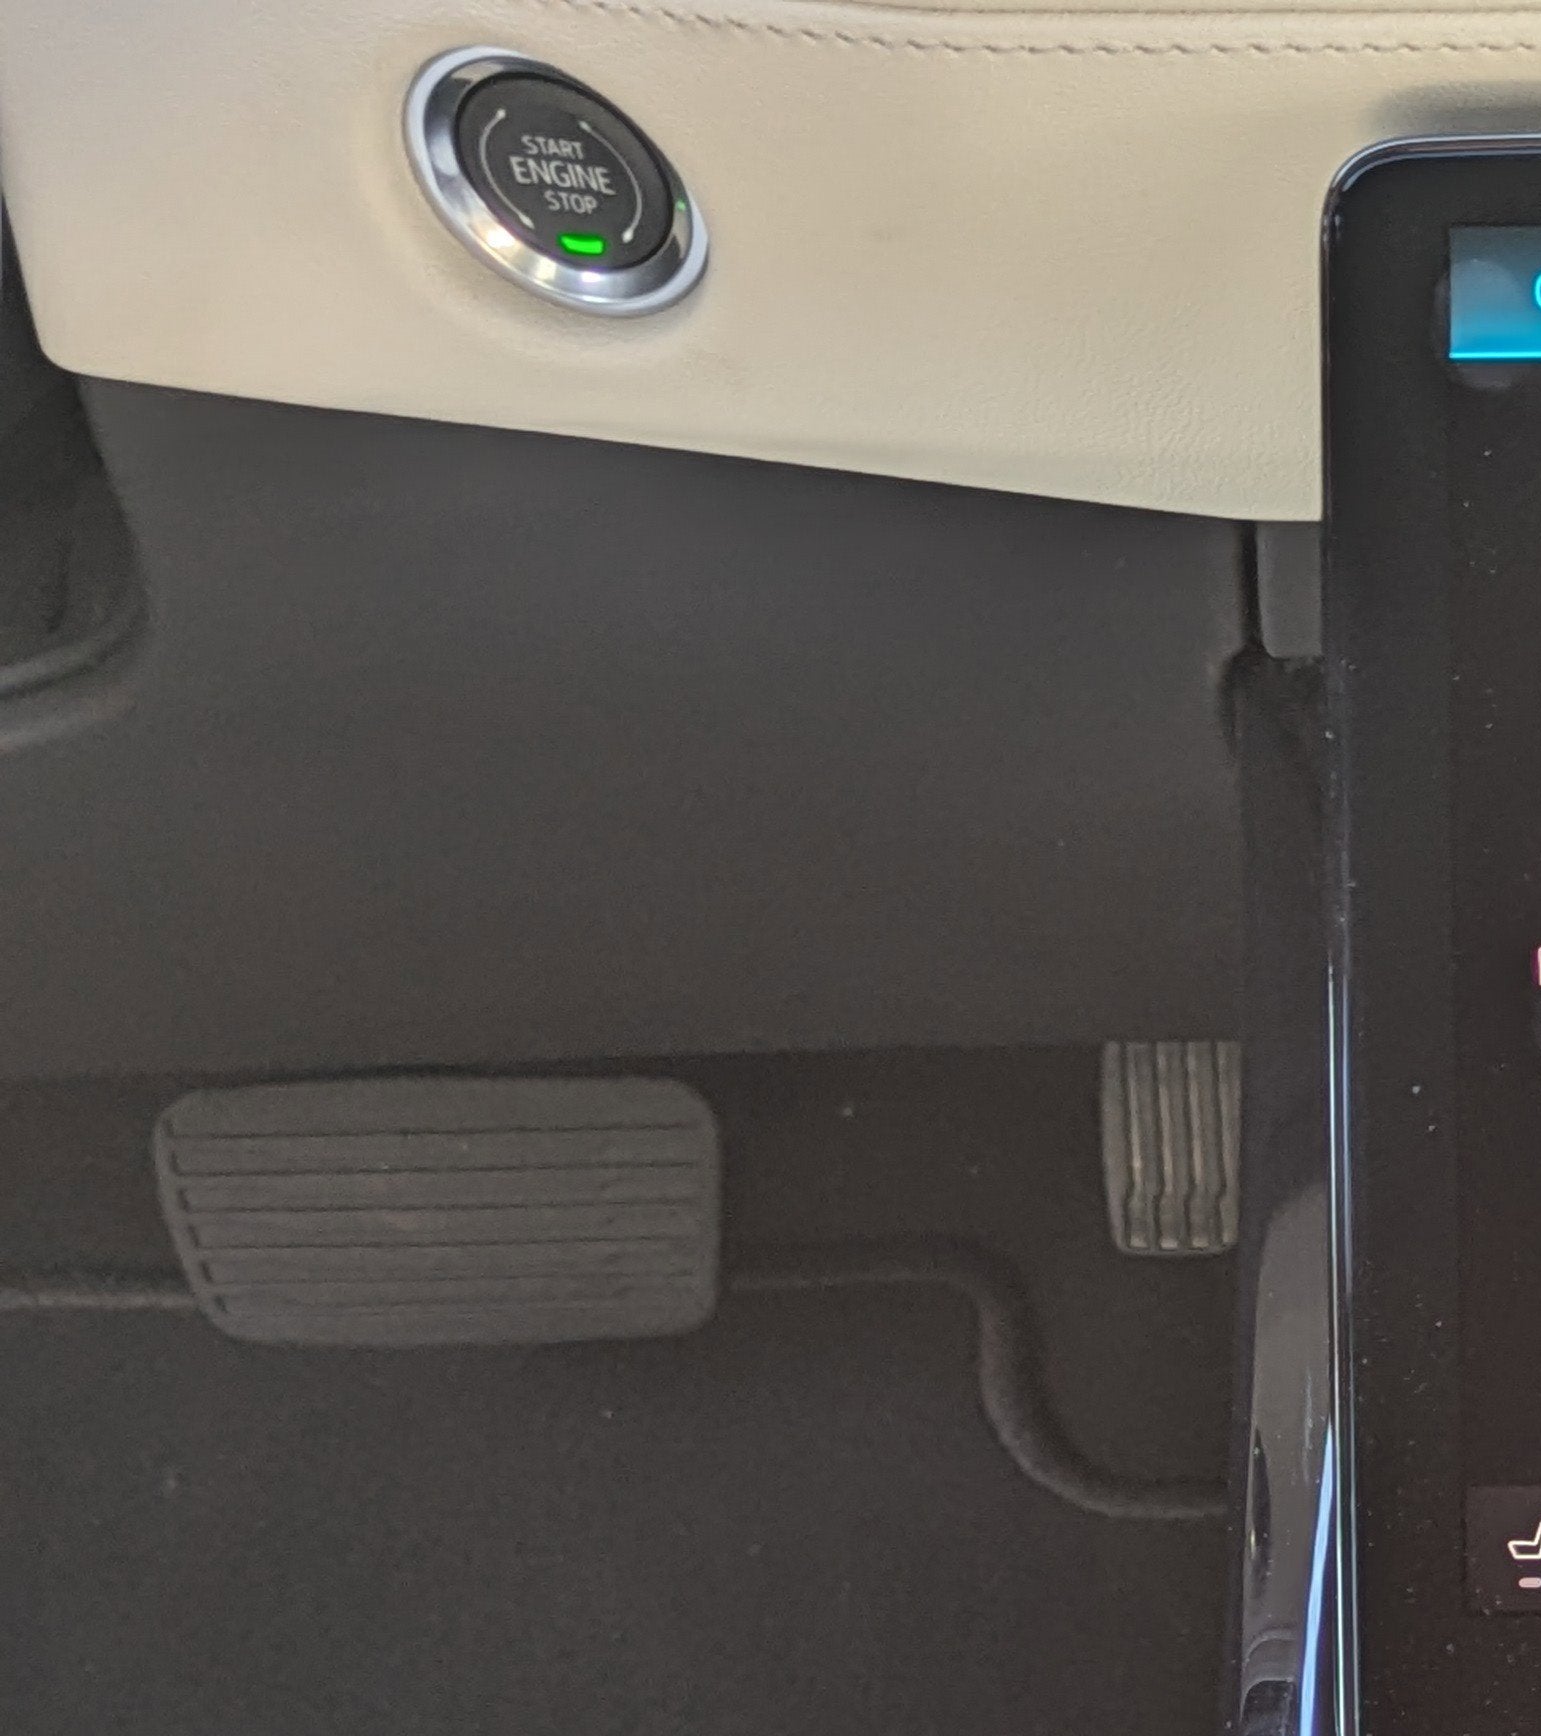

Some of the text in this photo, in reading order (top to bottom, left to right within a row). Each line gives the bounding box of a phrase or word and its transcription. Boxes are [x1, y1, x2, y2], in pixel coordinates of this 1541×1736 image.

[522, 136, 583, 160] START
[511, 156, 615, 195] ENGINE
[546, 191, 598, 214] STOP
